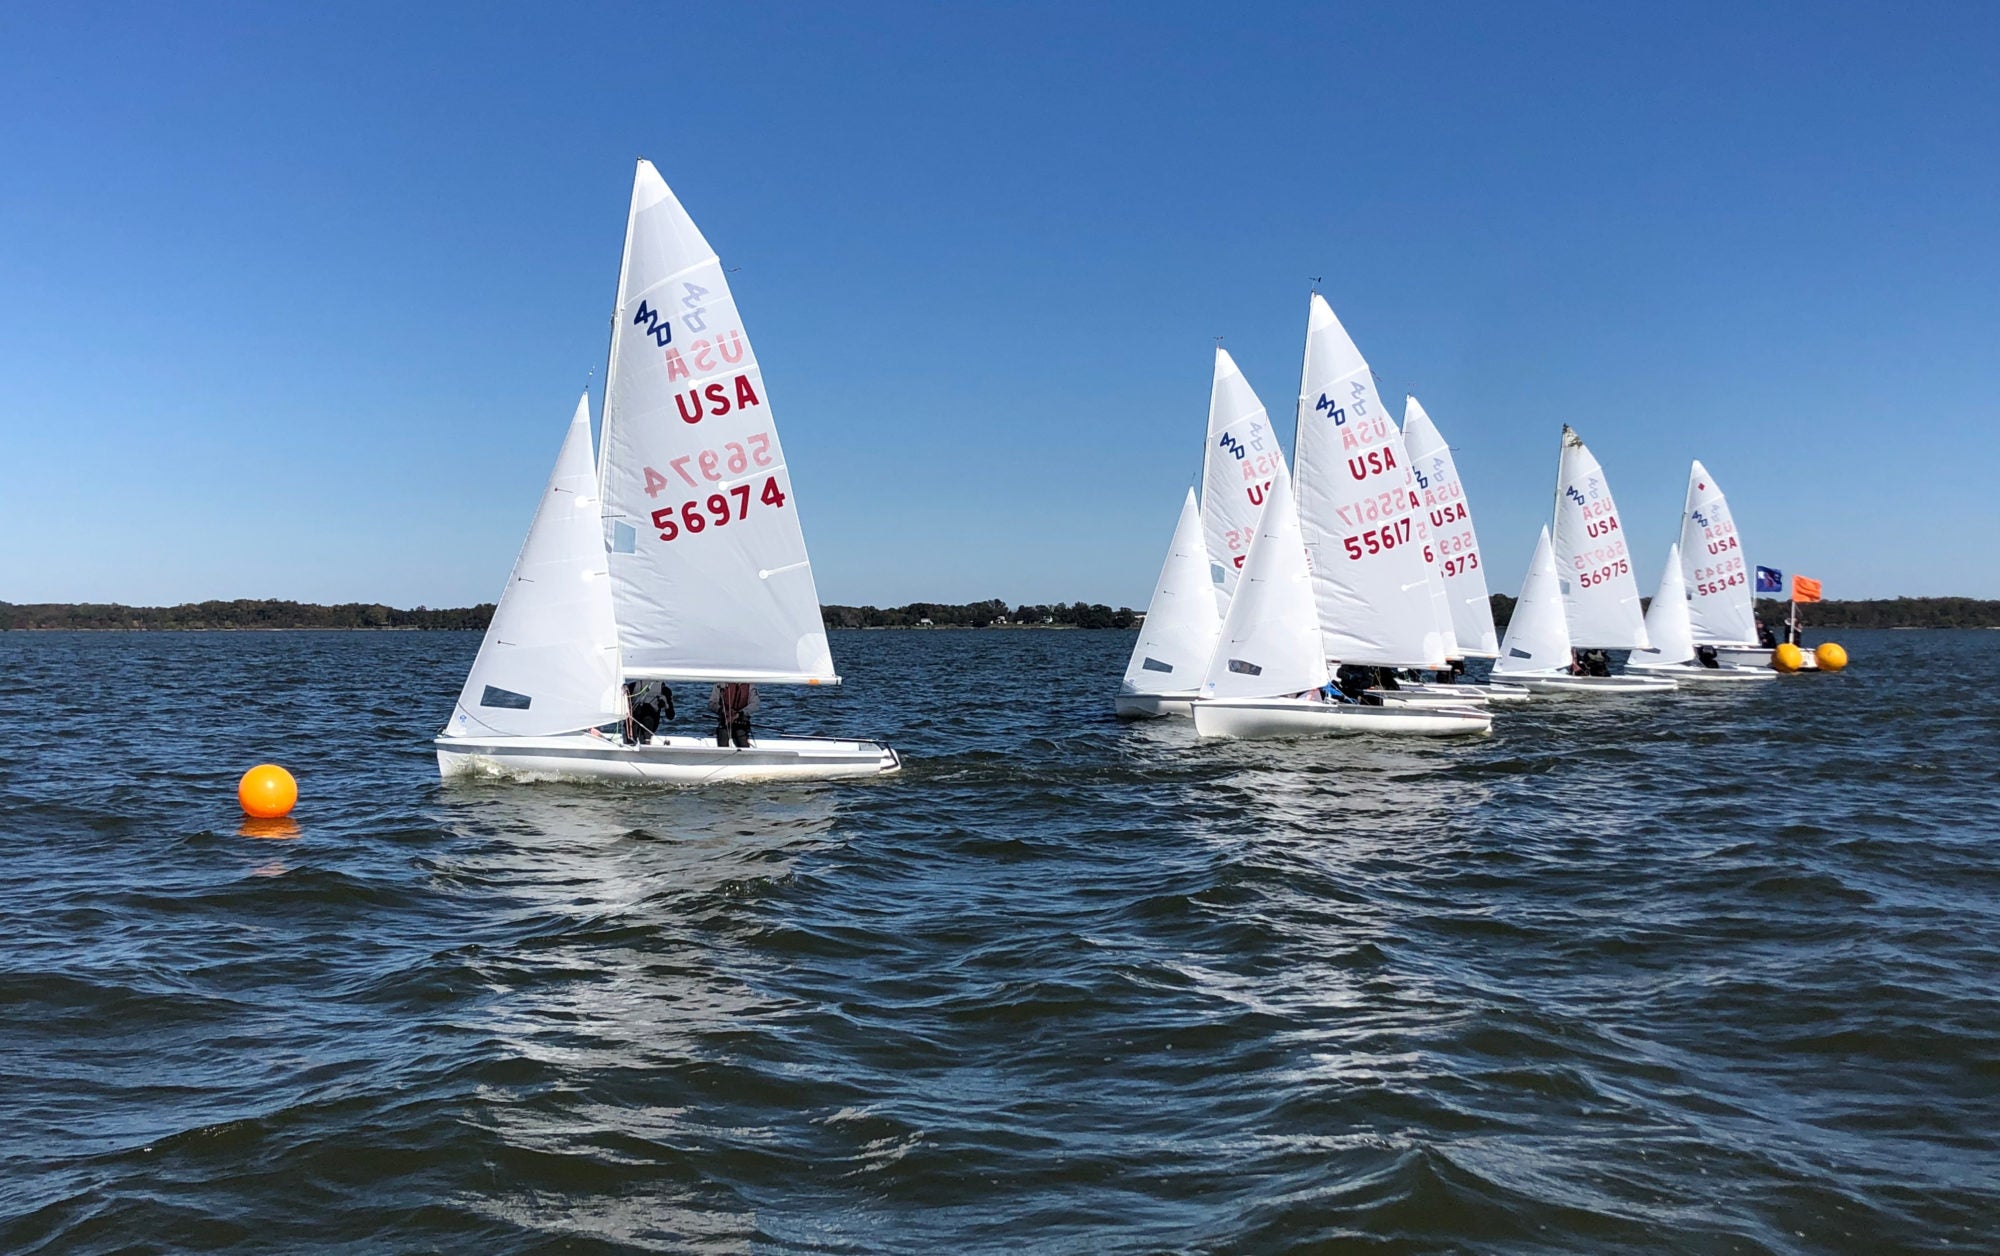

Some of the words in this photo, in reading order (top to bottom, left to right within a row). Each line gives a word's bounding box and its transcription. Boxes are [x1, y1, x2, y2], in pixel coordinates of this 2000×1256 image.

[633, 300, 672, 347] 420
[675, 374, 759, 424] USA
[1315, 392, 1346, 426] 420
[1219, 431, 1245, 460] 420
[1348, 447, 1397, 481] USA
[1412, 466, 1428, 489] 20
[651, 476, 786, 541] 56974
[1566, 485, 1585, 506] 420
[1430, 502, 1467, 527] USA
[1587, 516, 1618, 538] USA
[1691, 510, 1708, 528] 420
[1343, 517, 1410, 560] 55617
[1707, 536, 1737, 555] USA
[1441, 553, 1478, 578] 973
[1580, 559, 1628, 588] 56975
[1697, 572, 1745, 596] 56343
